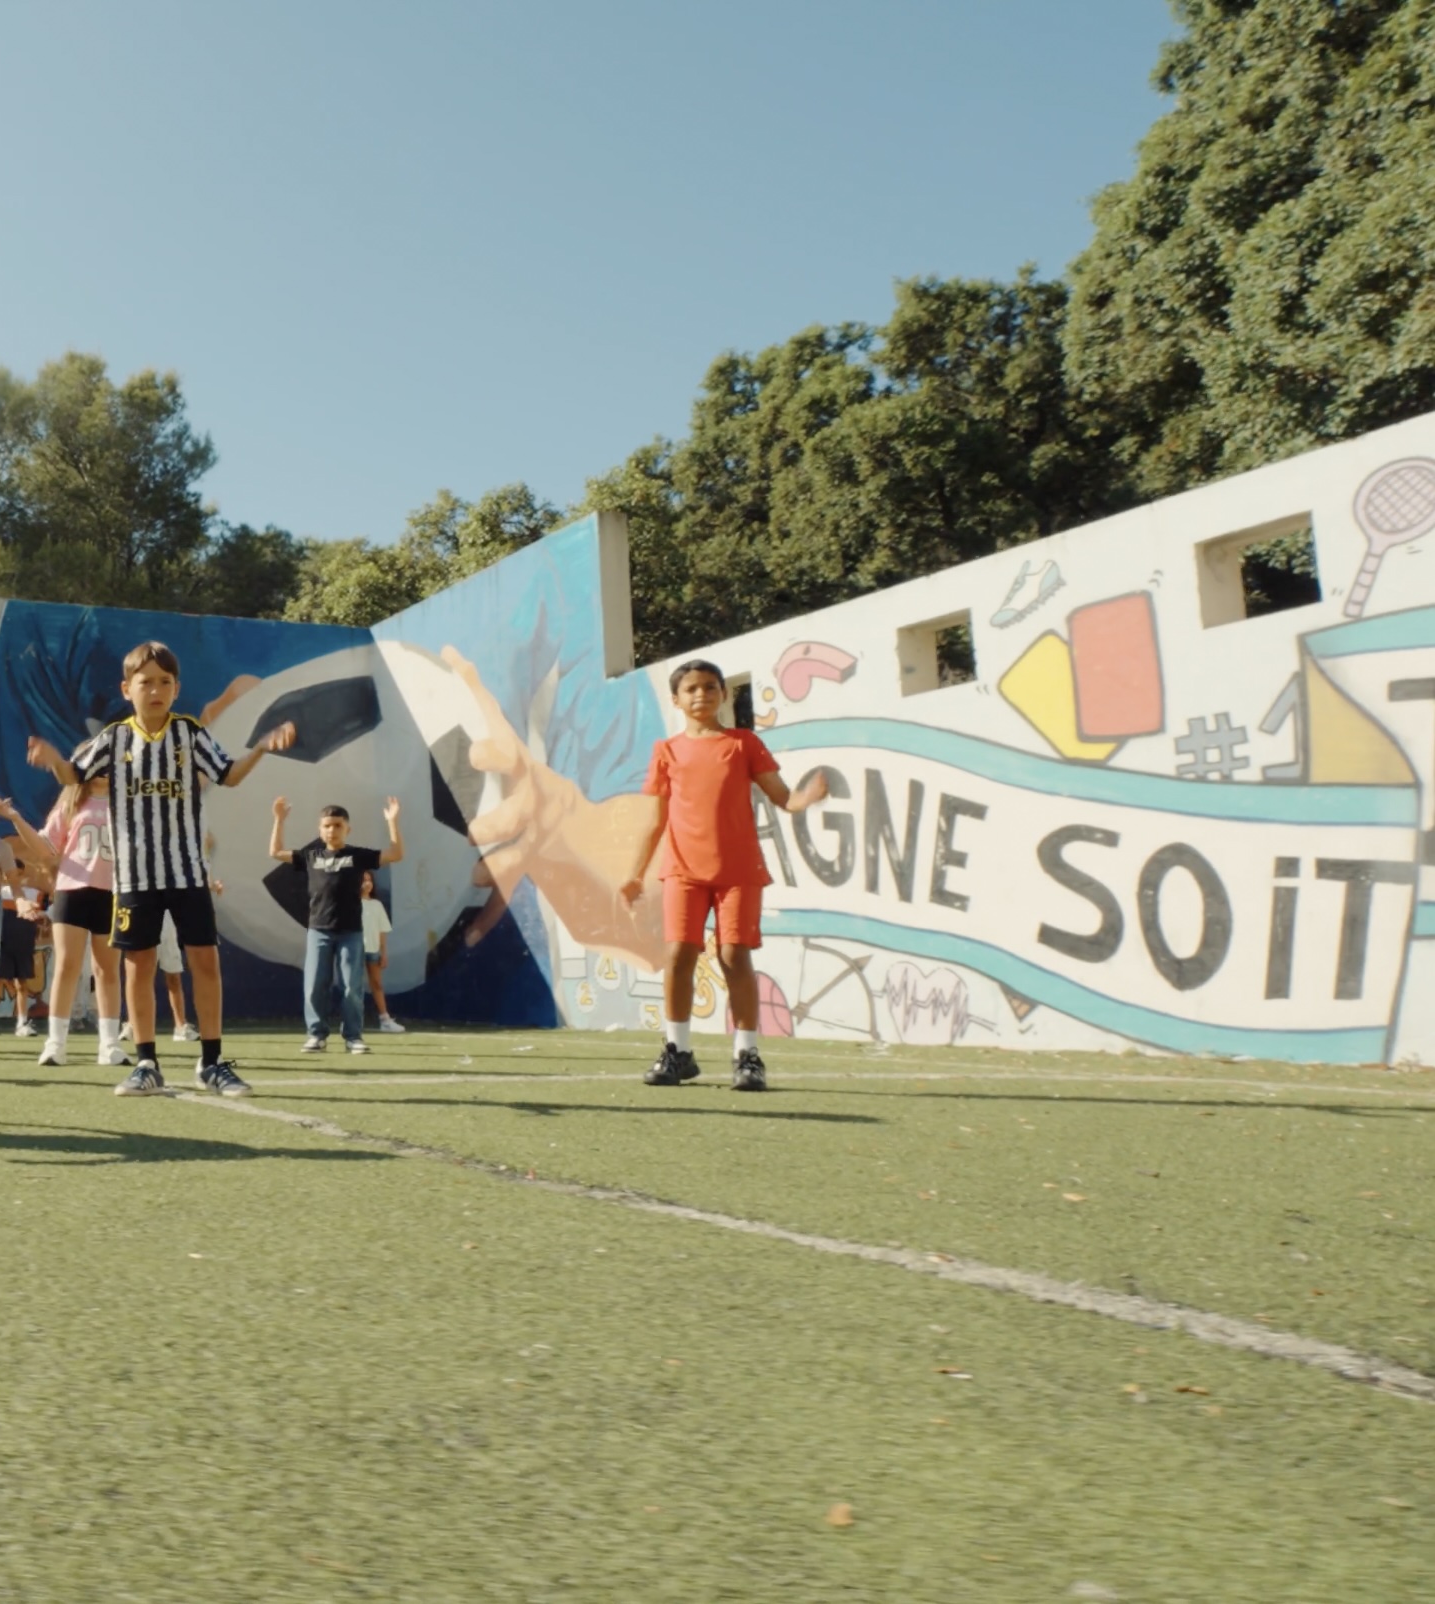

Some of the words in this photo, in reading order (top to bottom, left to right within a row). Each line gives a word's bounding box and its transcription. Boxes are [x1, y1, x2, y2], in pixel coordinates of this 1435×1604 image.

[126, 776, 185, 799] Jeep
[751, 764, 990, 914] AGNE
[579, 982, 593, 1005] 2
[645, 1005, 661, 1030] 3
